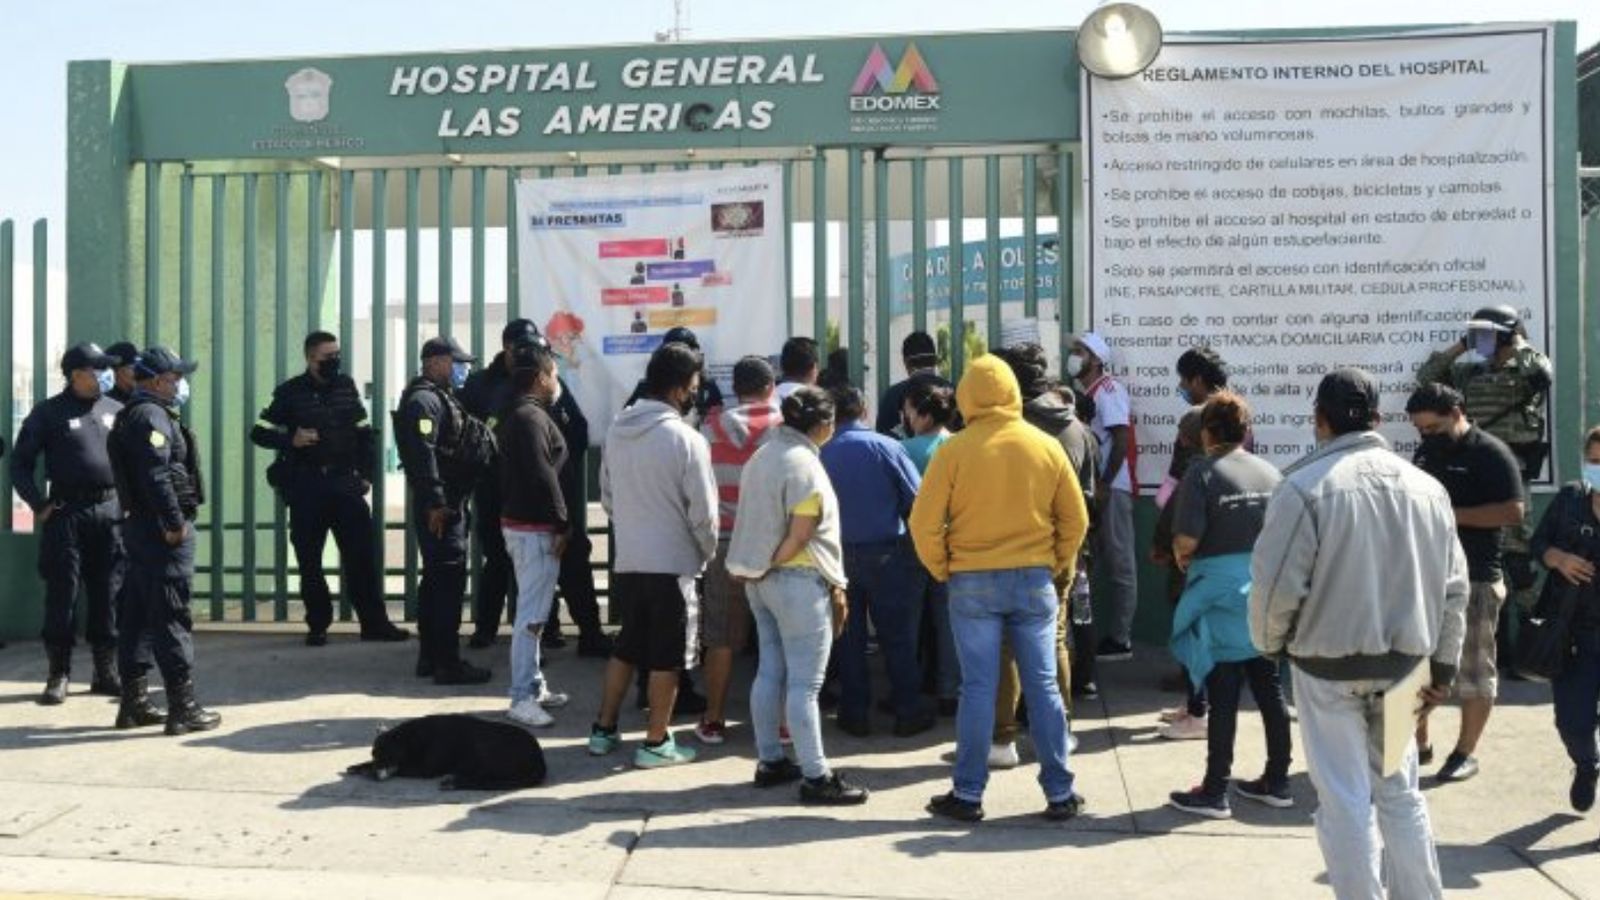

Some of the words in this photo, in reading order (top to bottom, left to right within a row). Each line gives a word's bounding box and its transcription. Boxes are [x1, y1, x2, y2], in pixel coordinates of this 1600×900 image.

[390, 63, 596, 96] HOSPITAL
[621, 53, 825, 88] GENERAL
[1143, 66, 1268, 82] REGLAMENTO
[1273, 66, 1354, 79] INTERNO
[1358, 64, 1395, 77] DEL
[1400, 59, 1490, 75] HOSPITAL
[850, 94, 940, 111] EDOMEX
[437, 107, 522, 137] LAS
[542, 99, 777, 134] AMERICAS
[1109, 110, 1130, 122] Se
[1138, 109, 1193, 124] prohibe
[1201, 110, 1215, 121] el
[1223, 110, 1277, 121] acceso
[1285, 110, 1312, 120] con
[1400, 104, 1445, 118] bultos
[1454, 102, 1513, 118] grandes
[1522, 102, 1532, 116] y
[1102, 131, 1150, 143] bolsas
[1154, 131, 1172, 143] de
[1176, 131, 1218, 142] mano
[1110, 158, 1163, 172] Acceso
[1166, 158, 1242, 174] restringido
[1246, 157, 1264, 170] de
[1269, 156, 1335, 169] celulares
[1338, 158, 1357, 168] en
[1361, 154, 1394, 167] área
[1398, 153, 1417, 166] de
[1111, 188, 1131, 201] Se
[1134, 188, 1190, 203] prohibe
[1194, 188, 1208, 200] el
[1212, 188, 1264, 200] acceso
[1269, 185, 1287, 198] de
[1353, 184, 1422, 197] bicicletas
[1426, 186, 1435, 198] y
[548, 212, 622, 226] PRESENTAS
[1111, 215, 1131, 228] Se
[1135, 214, 1190, 230] prohibe
[1196, 213, 1209, 227] el
[1214, 215, 1266, 226] acceso
[1270, 213, 1284, 226] al
[1288, 211, 1346, 227] hospital
[1350, 213, 1369, 224] en
[1374, 211, 1426, 223] estado
[1430, 208, 1448, 222] de
[1452, 207, 1516, 221] ebriedad
[1521, 209, 1532, 219] o
[1104, 236, 1135, 251] bajo
[1139, 236, 1151, 248] el
[1156, 235, 1202, 248] efecto
[1205, 235, 1224, 247] de
[1228, 234, 1268, 249] algún
[1111, 264, 1144, 278] Solo
[1148, 266, 1165, 277] se
[1169, 263, 1234, 277] permitirá
[1237, 263, 1252, 276] el
[1256, 264, 1309, 276] acceso
[1313, 264, 1340, 274] con
[1345, 259, 1440, 274] identificación
[1443, 257, 1486, 271] oficial
[1229, 284, 1296, 297] CARTILLA
[1361, 282, 1417, 294] CEDULA
[1111, 313, 1130, 326] En
[1138, 316, 1174, 326] caso
[1180, 313, 1199, 326] de
[1205, 316, 1225, 326] no
[1232, 313, 1279, 326] contar
[1285, 314, 1314, 326] con
[1320, 313, 1370, 327] alguna
[1377, 309, 1472, 325] identificación
[1104, 334, 1173, 348] presentar
[1178, 333, 1278, 347] CONSTANCIA
[1281, 332, 1385, 347] DOMICILIARIA
[1388, 331, 1424, 345] CON
[1111, 363, 1129, 375] La
[1136, 366, 1169, 378] ropa
[1296, 362, 1329, 375] solo
[1251, 383, 1270, 396] de
[1273, 384, 1301, 396] alta
[1306, 386, 1313, 398] y
[1143, 413, 1176, 425] hora
[1246, 412, 1275, 425] olo
[1273, 444, 1300, 454] con
